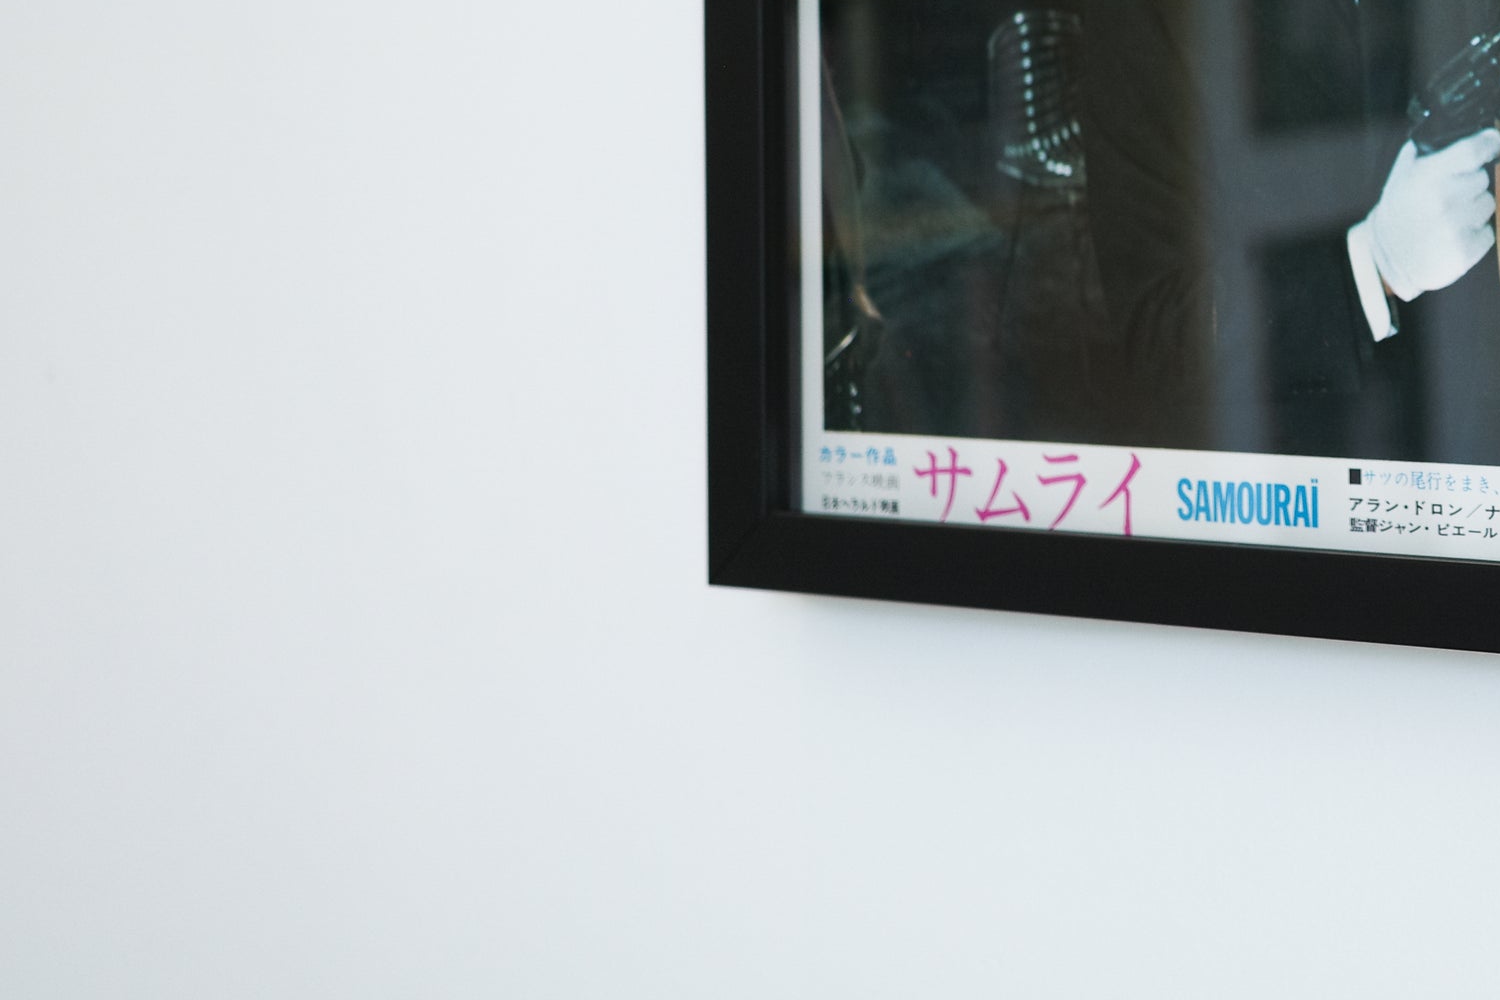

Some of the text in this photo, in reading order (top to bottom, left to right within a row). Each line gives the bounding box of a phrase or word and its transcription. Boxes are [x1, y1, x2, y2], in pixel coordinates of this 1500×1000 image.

[914, 446, 1142, 536] サムライ
[1177, 477, 1319, 529] SAMOURAÏ
